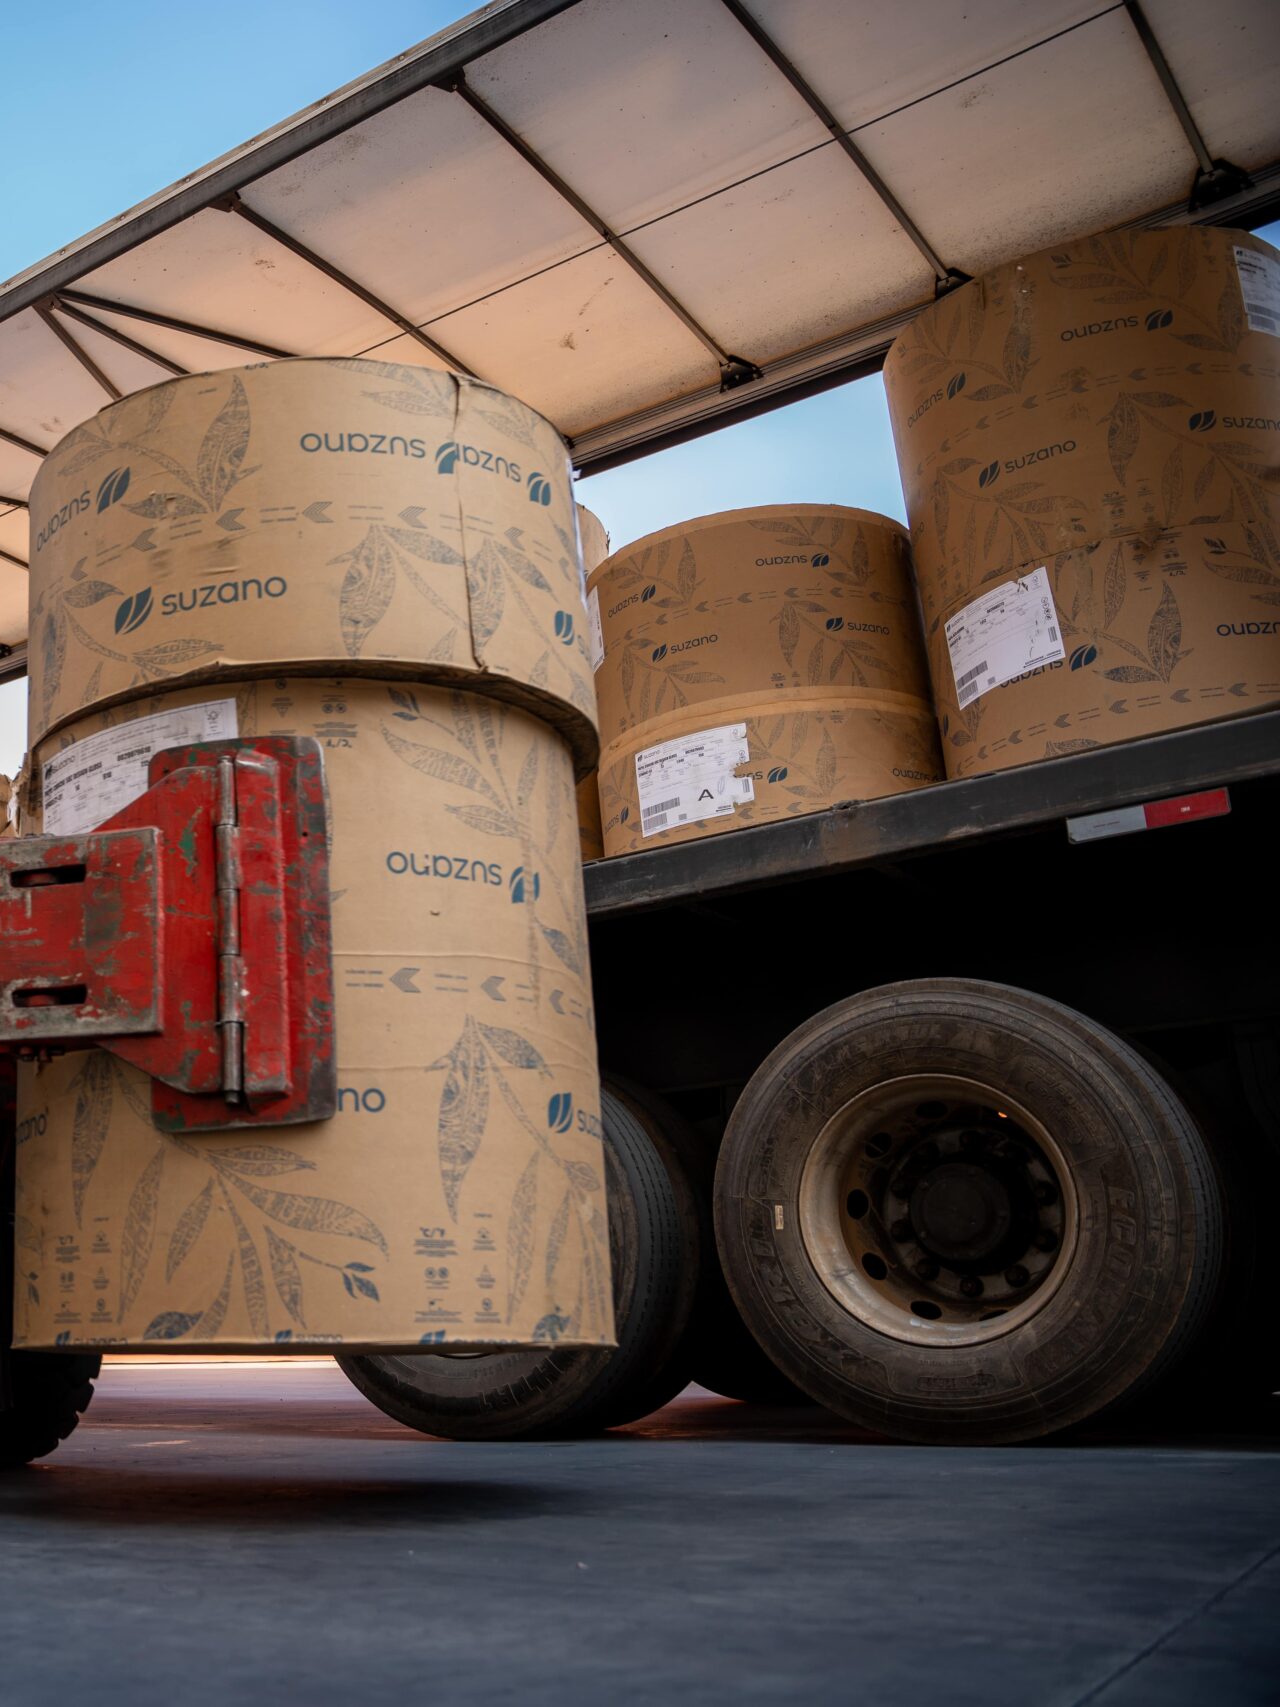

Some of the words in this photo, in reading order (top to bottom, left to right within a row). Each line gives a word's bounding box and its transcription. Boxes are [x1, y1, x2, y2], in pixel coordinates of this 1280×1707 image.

[1061, 316, 1138, 342] suzano
[907, 389, 944, 428] suzano
[300, 432, 426, 458] suzano
[1005, 440, 1077, 474] suzano
[37, 490, 91, 551] suzano
[755, 555, 807, 567] suzano
[161, 576, 288, 615] suzano
[608, 594, 639, 618] suzano
[847, 622, 890, 636] suzano
[1217, 623, 1280, 637] uzano
[670, 633, 718, 654] suzano
[698, 789, 714, 802] A
[387, 851, 502, 886] suzano
